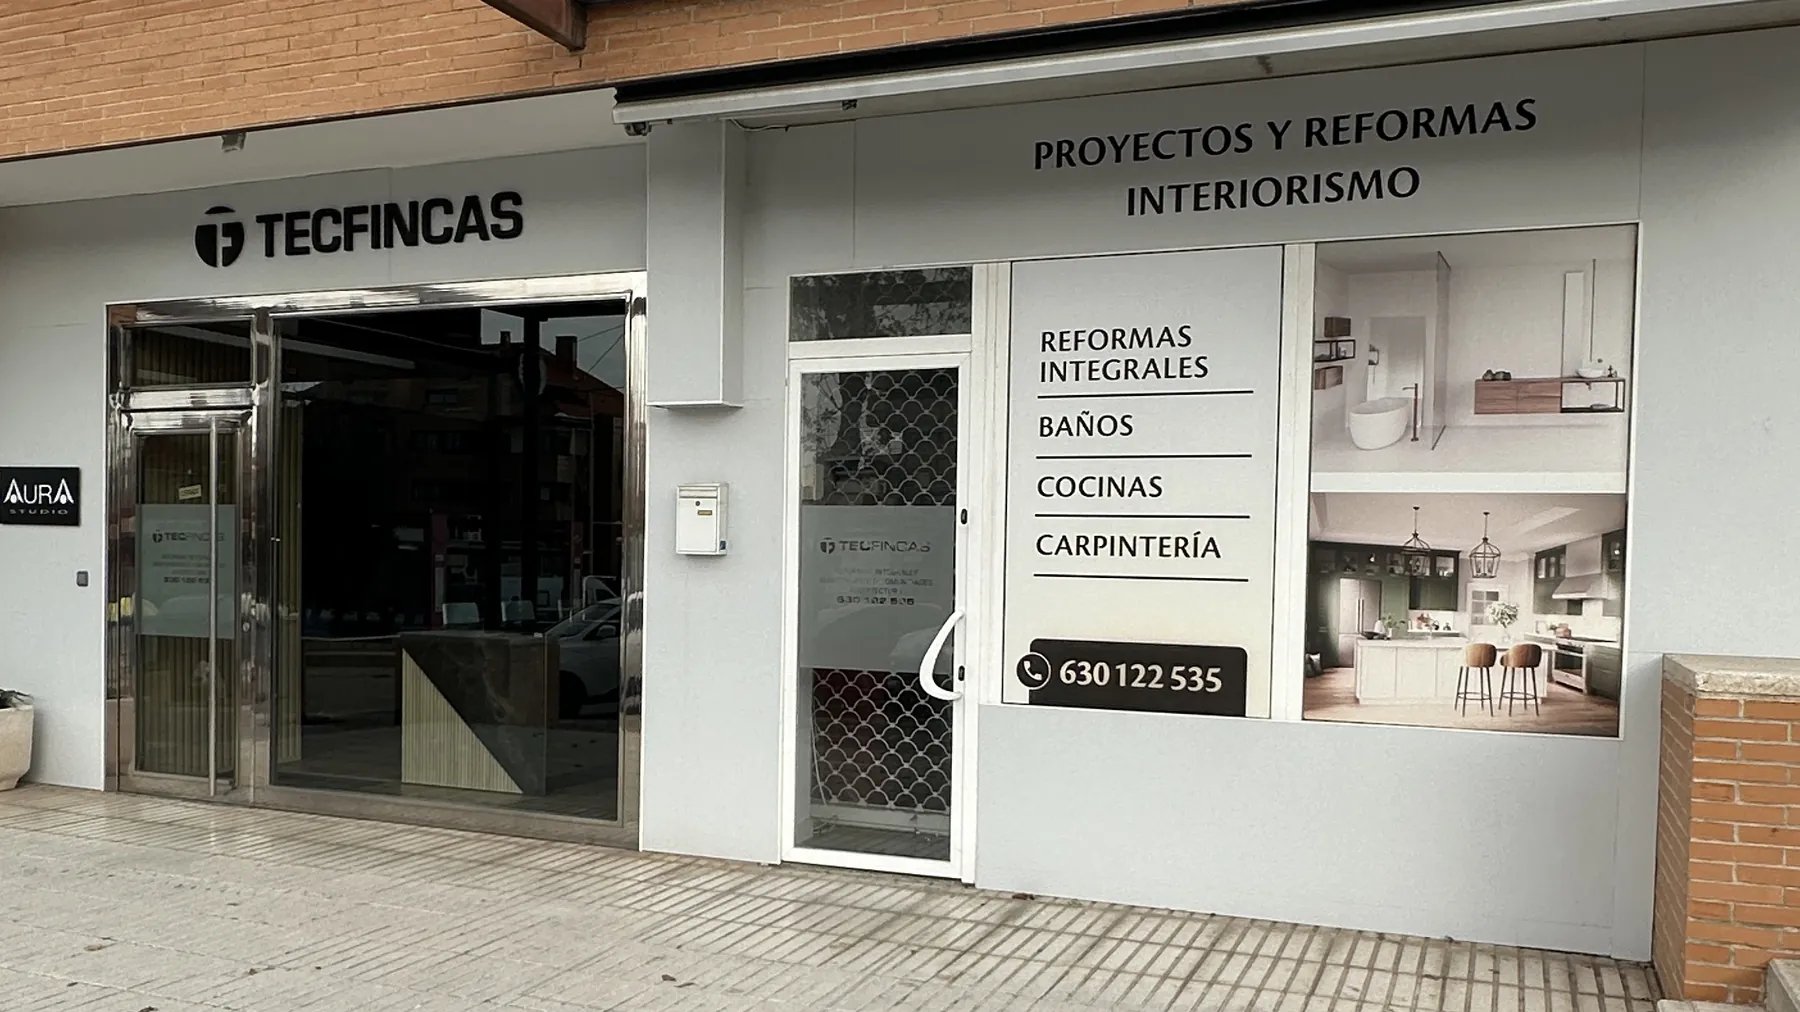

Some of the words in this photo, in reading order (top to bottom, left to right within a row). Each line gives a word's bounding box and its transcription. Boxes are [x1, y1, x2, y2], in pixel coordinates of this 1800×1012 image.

[1034, 122, 1253, 170] PROYECTOS
[1268, 119, 1292, 151] Y
[1305, 98, 1537, 148] REFORMAS
[1126, 166, 1420, 216] INTERIORISMO
[256, 190, 524, 258] TECFINCAS
[1040, 325, 1192, 353] REFORMAS
[1040, 356, 1209, 383] INTEGRALES
[1039, 410, 1134, 438] BAÑOS
[1037, 475, 1163, 498] COCINAS
[838, 540, 931, 553] TECFINCAS
[1035, 531, 1222, 559] CARPINTERÍA
[1059, 660, 1111, 686] 630
[1116, 663, 1164, 688] 122
[1170, 665, 1222, 693] 535
